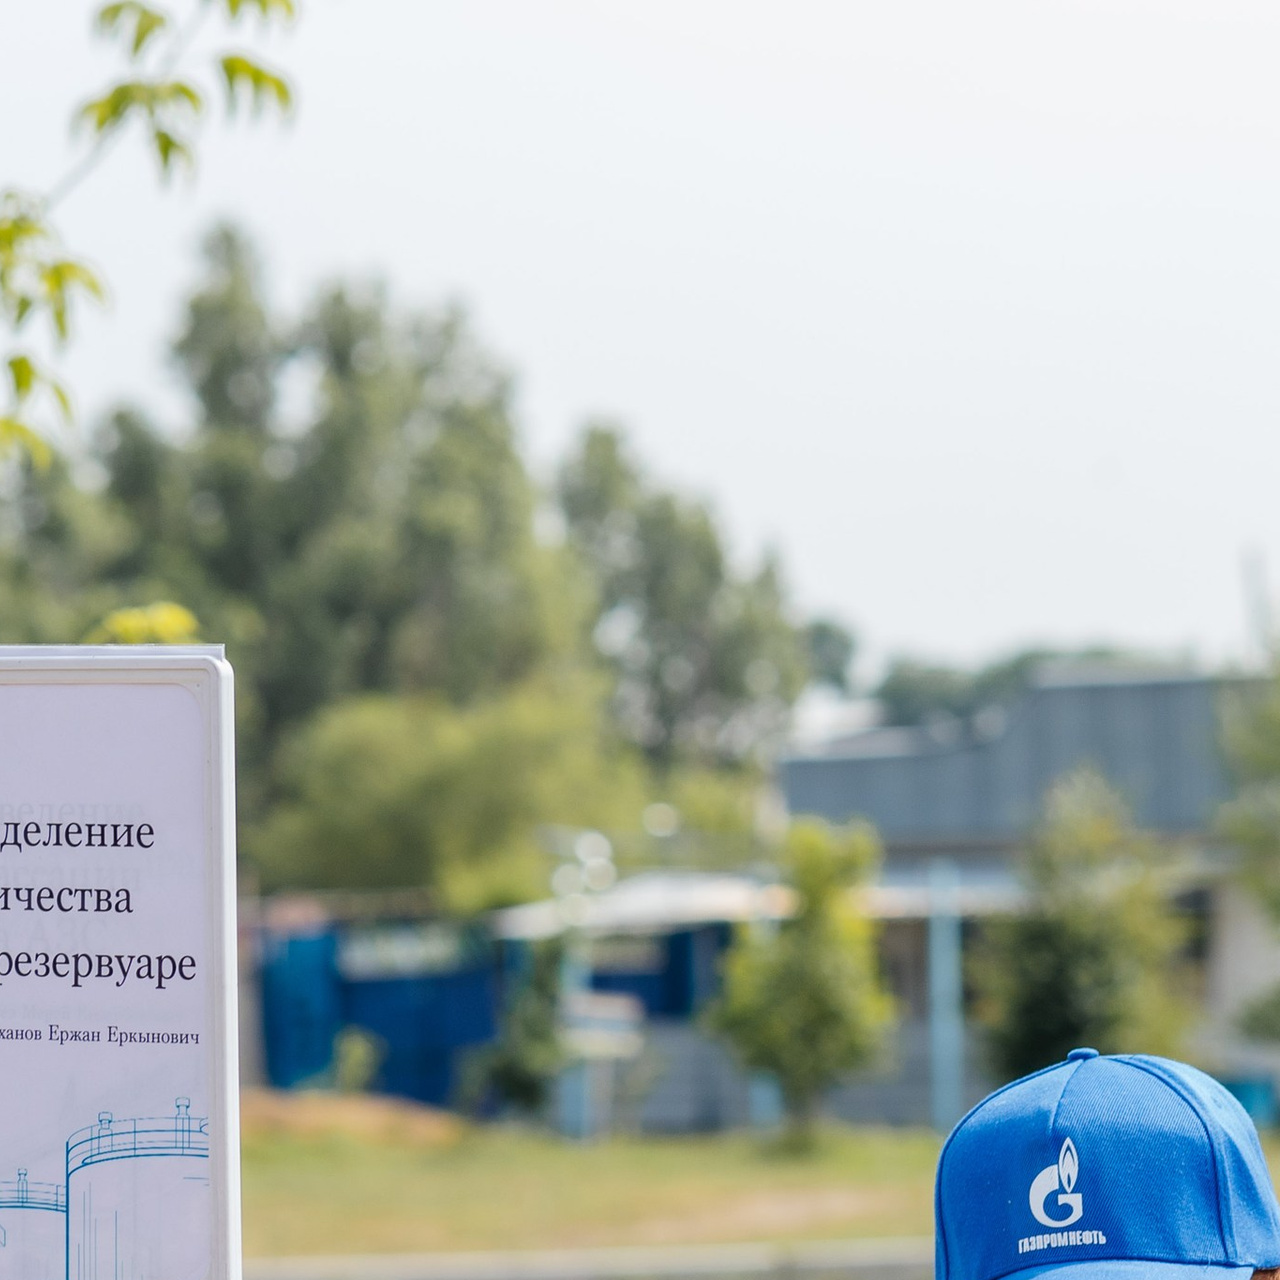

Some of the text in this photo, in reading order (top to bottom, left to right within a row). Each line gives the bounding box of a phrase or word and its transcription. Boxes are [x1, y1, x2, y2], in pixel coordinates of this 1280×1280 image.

[0, 820, 155, 854] деление
[48, 1025, 101, 1046] Ержан
[107, 1026, 200, 1047] Еркынович
[1018, 1230, 1107, 1254] ГАЗПРОМНЕФТЬ
